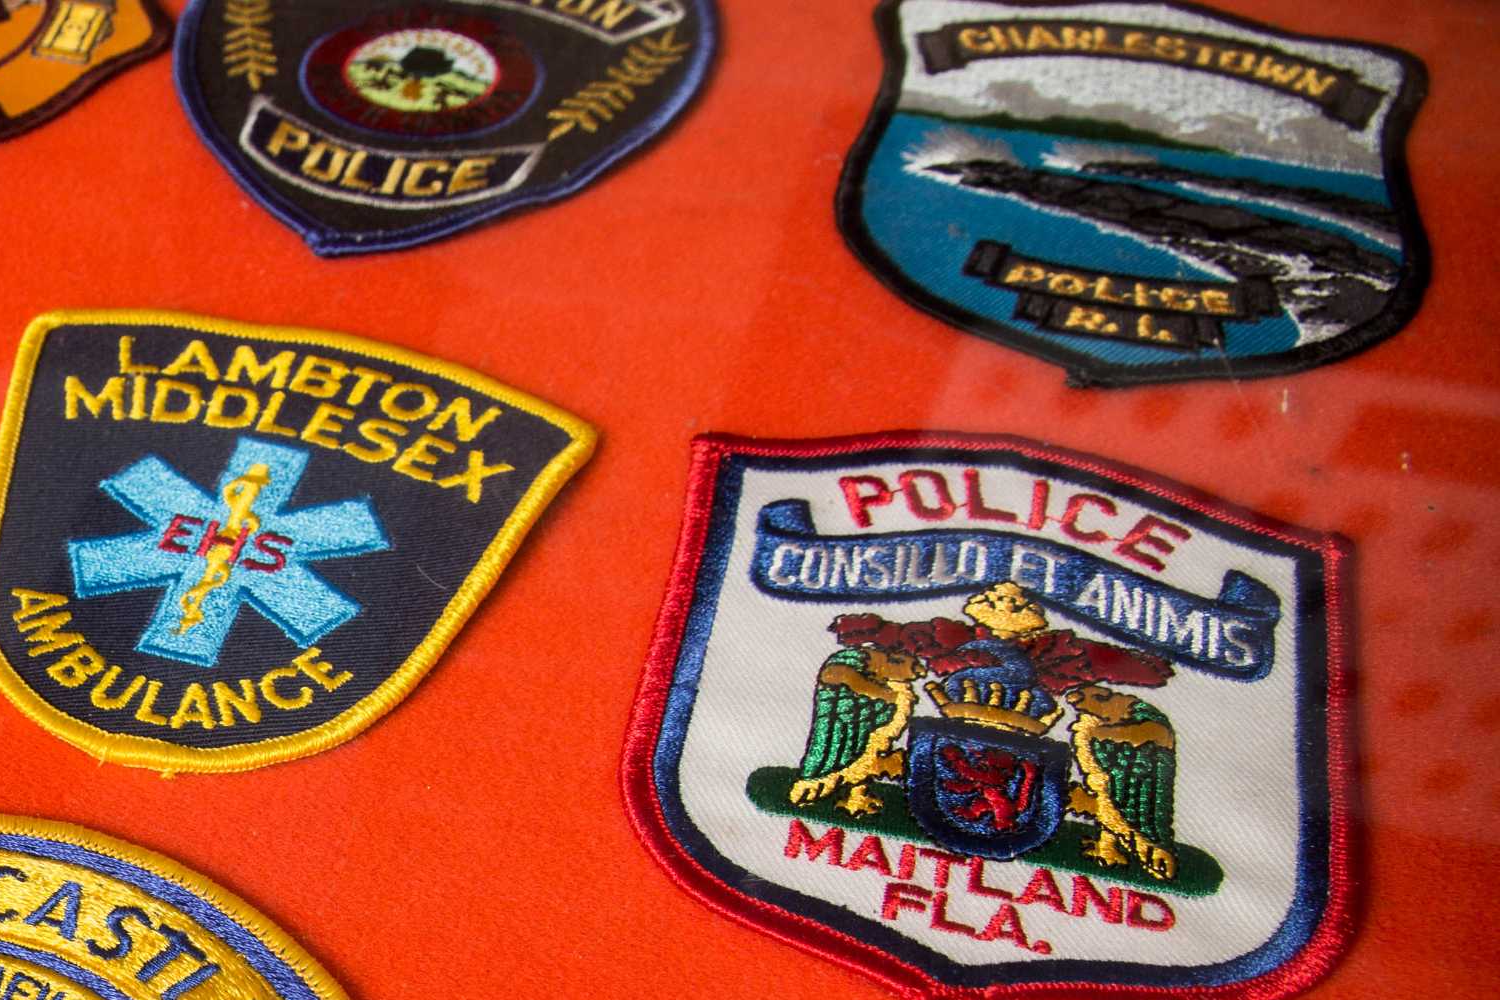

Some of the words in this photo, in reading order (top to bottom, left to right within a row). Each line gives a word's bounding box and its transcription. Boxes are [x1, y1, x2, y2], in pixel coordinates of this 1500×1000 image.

[957, 25, 1338, 97] CHARLESTOWN
[265, 119, 496, 197] POLICE
[1004, 263, 1237, 315] POLICE
[64, 375, 515, 503] MIDDLESEX
[119, 335, 502, 442] LAMBTON
[156, 513, 293, 572] EHS
[838, 468, 1192, 572] POLICE
[1010, 541, 1068, 590] ET
[1077, 571, 1256, 667] ANIMIS
[10, 587, 354, 729] AMBULANCE
[783, 819, 1176, 932] MAITLAND
[878, 881, 1053, 955] FLA.
